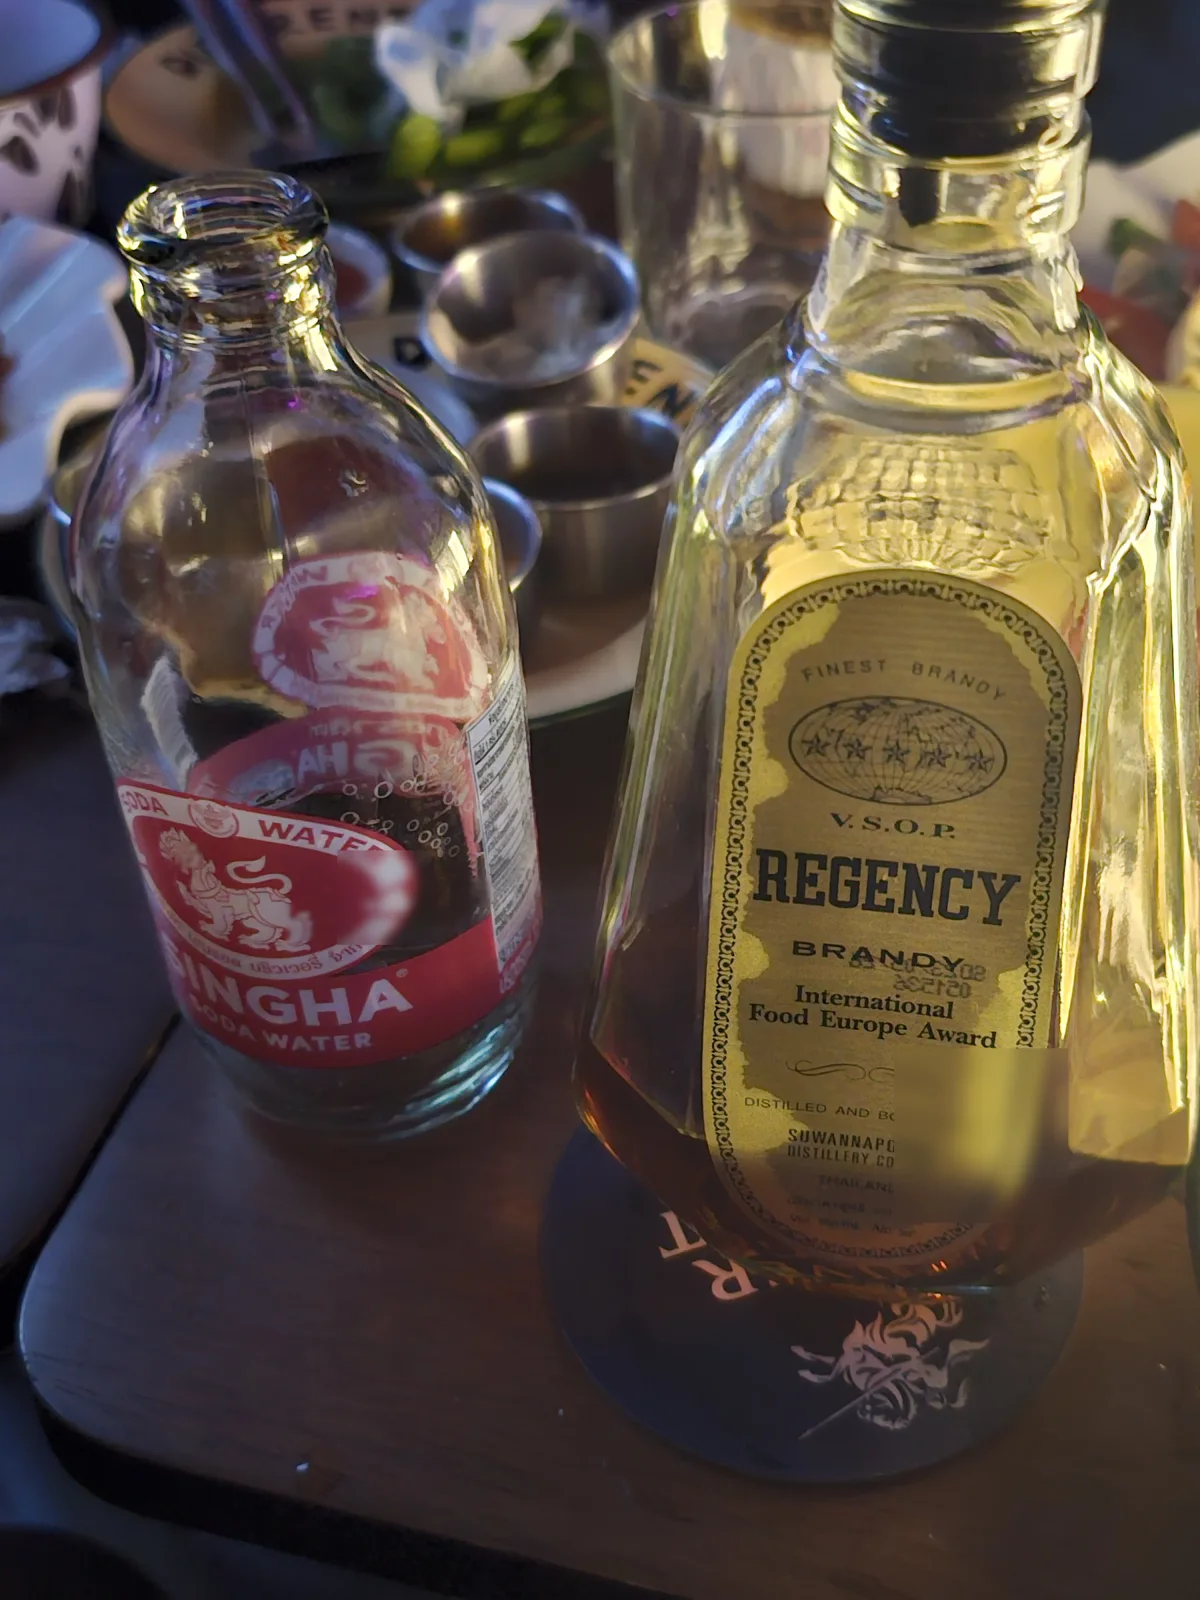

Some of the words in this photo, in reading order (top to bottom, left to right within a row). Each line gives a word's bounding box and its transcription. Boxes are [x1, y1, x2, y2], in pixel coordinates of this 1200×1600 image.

[801, 659, 887, 682] FINEST
[911, 661, 1006, 701] BRANDY
[752, 848, 1021, 926] REGENCY
[792, 940, 966, 972] BRANDY
[795, 985, 954, 1020] International
[262, 1031, 372, 1052] WATER
[748, 1003, 809, 1026] Food
[819, 1010, 908, 1040] Europe
[917, 1022, 997, 1049] Award
[744, 1097, 828, 1113] DISTILLED
[835, 1106, 870, 1118] AND
